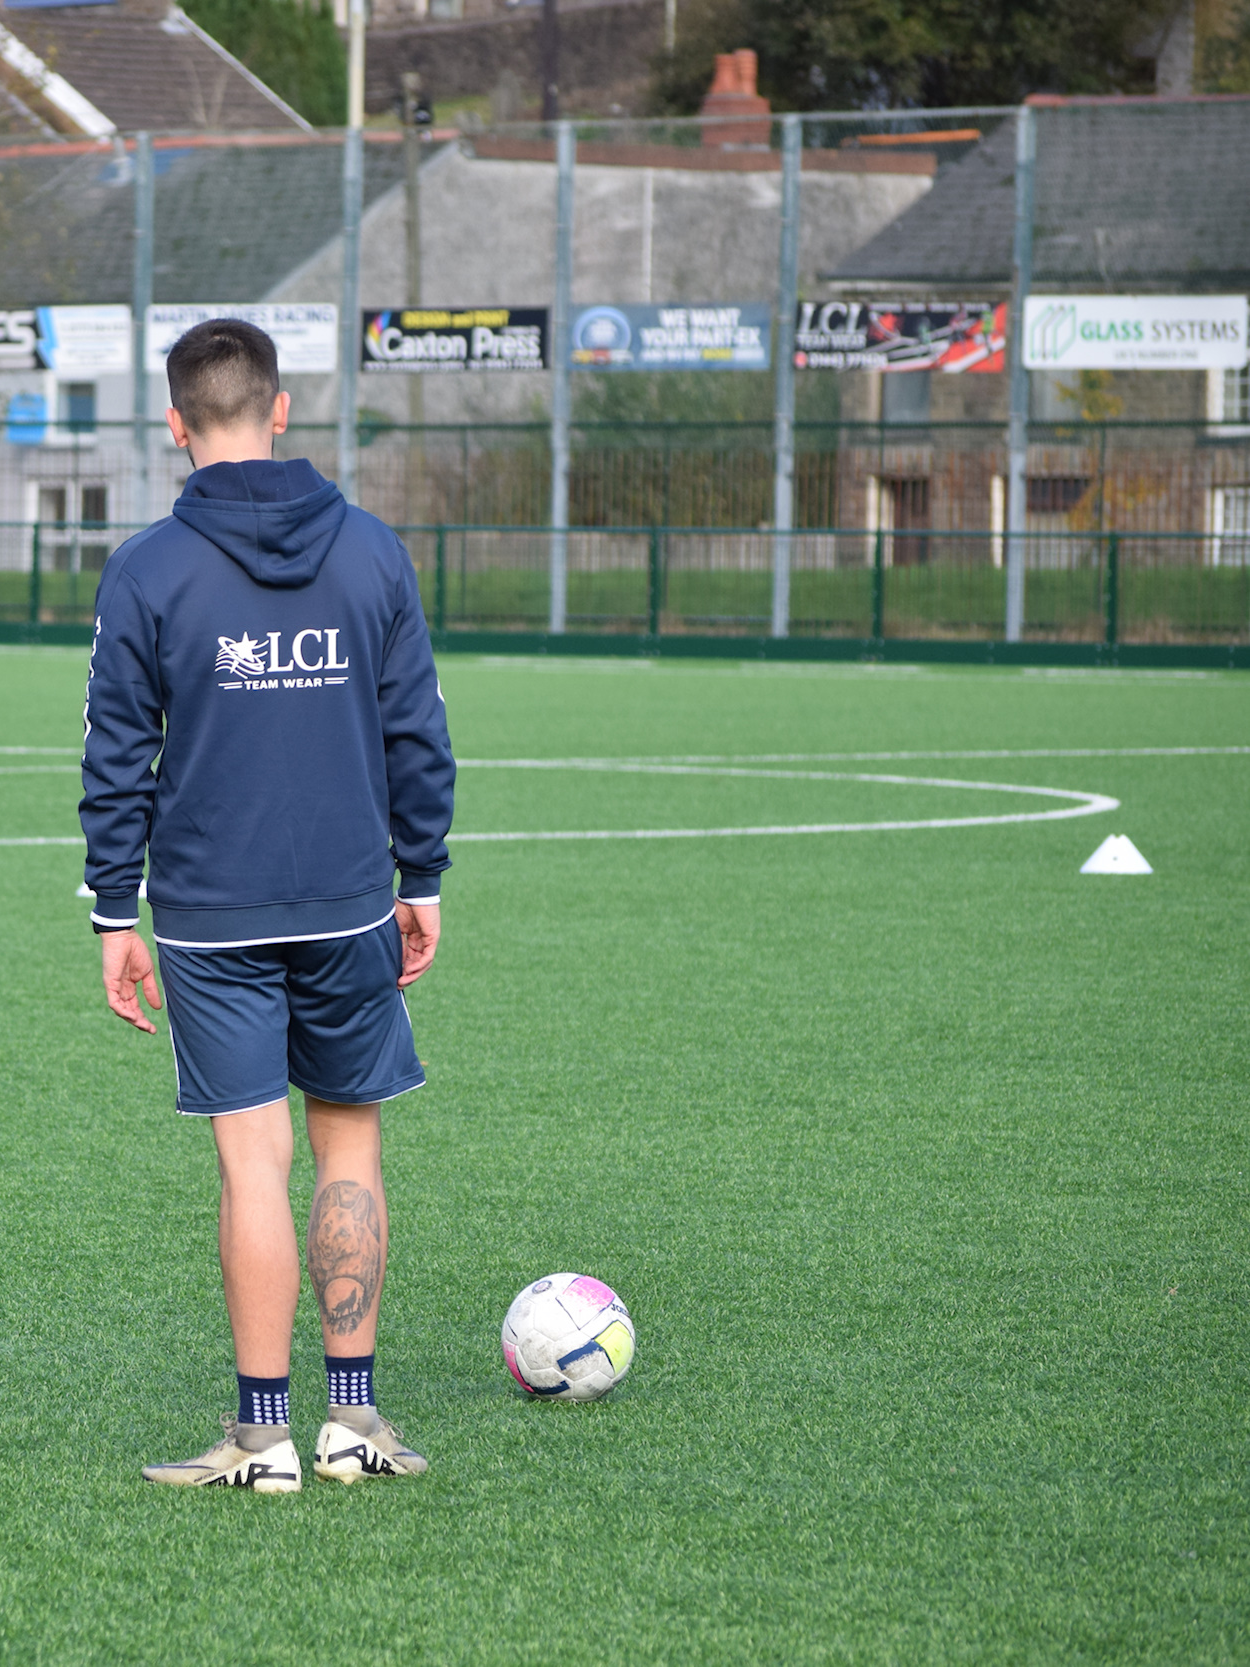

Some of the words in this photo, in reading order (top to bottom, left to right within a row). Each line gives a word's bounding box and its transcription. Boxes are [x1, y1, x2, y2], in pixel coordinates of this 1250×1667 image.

[274, 306, 334, 323] RACING
[657, 308, 688, 327] WE
[688, 307, 741, 327] WANT
[798, 301, 868, 335] LCL
[639, 327, 690, 348] YOUR
[690, 326, 761, 347] PART-EX
[1080, 319, 1145, 342] GLASS
[1151, 319, 1241, 342] SYSTEMS
[380, 327, 468, 361] Caxton
[471, 326, 541, 360] Press
[796, 333, 830, 351] TEAM
[830, 333, 867, 351] WEAR
[266, 628, 349, 673] LCL
[244, 678, 279, 691] TEAM
[282, 677, 323, 689] WEAR
